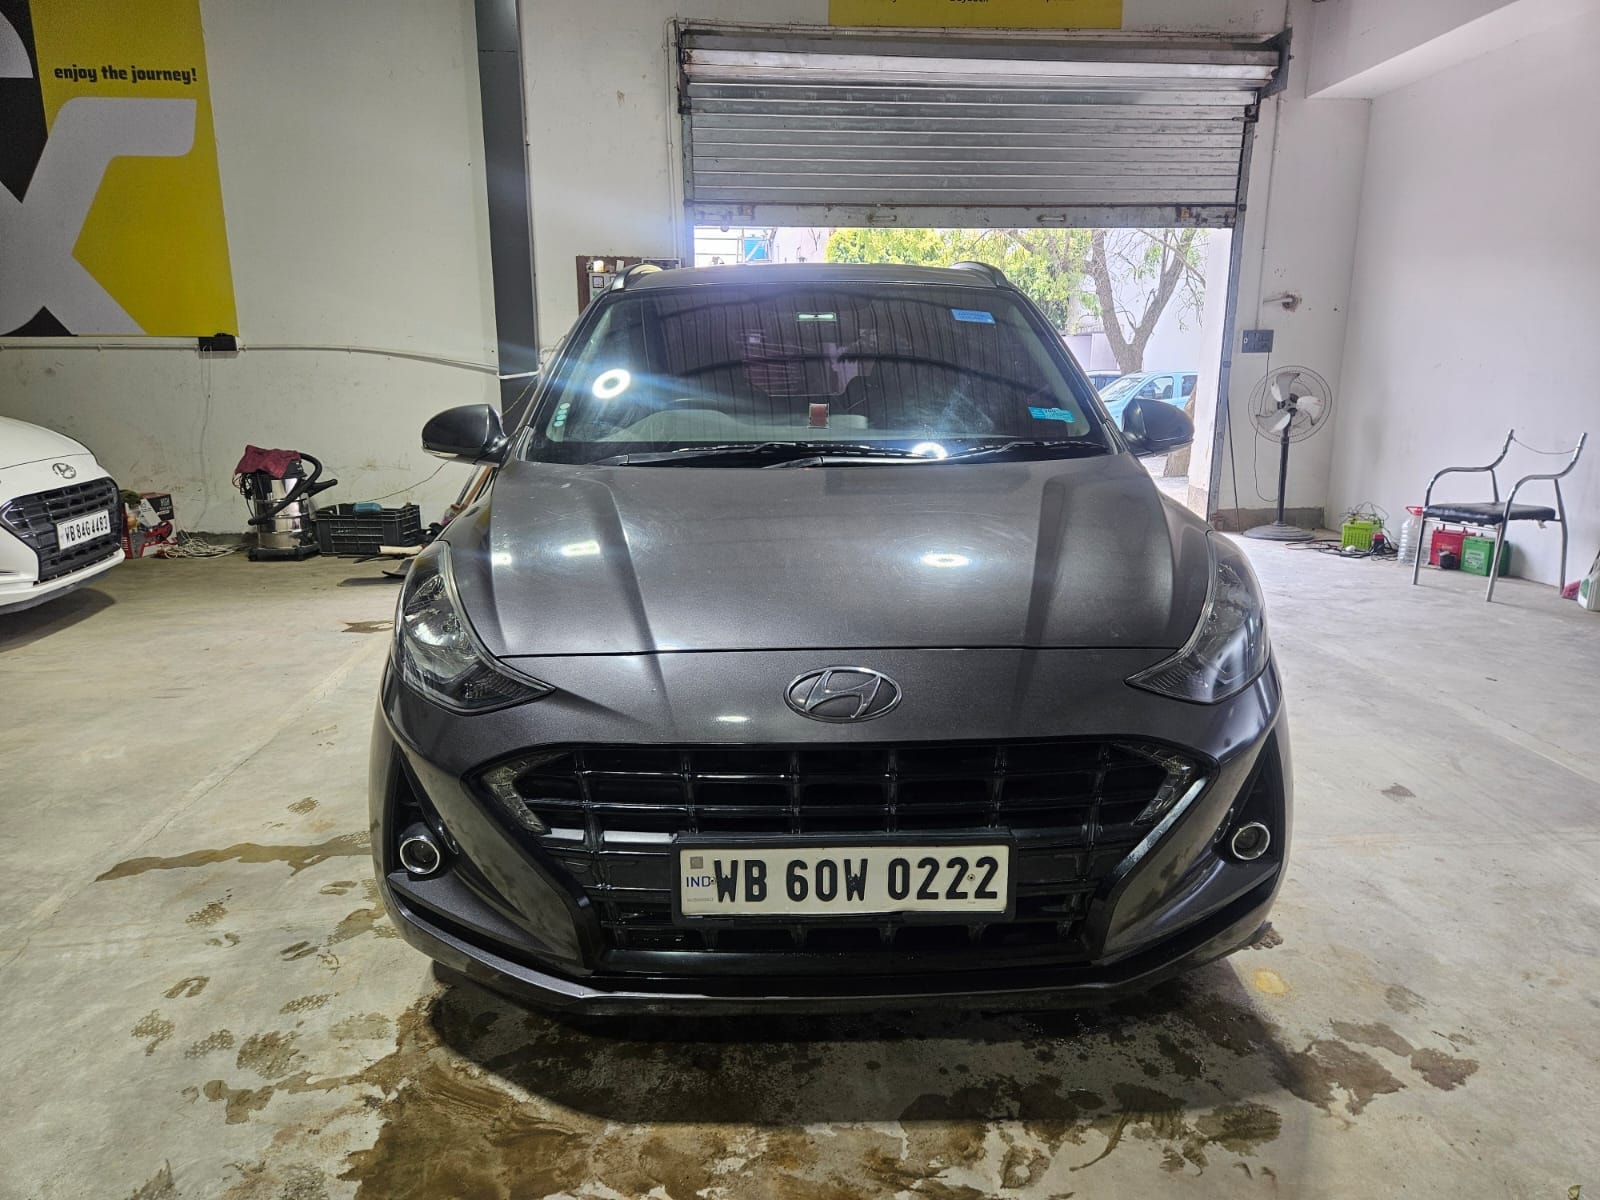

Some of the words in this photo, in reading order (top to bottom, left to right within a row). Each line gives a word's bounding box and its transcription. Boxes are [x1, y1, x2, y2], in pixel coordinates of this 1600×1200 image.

[54, 64, 97, 82] enjoy
[101, 64, 128, 80] the
[131, 65, 197, 85] journey!
[65, 525, 75, 544] WB
[686, 876, 711, 888] IND
[713, 859, 768, 902] WB
[785, 858, 868, 902] 60W
[887, 856, 999, 901] 0222
